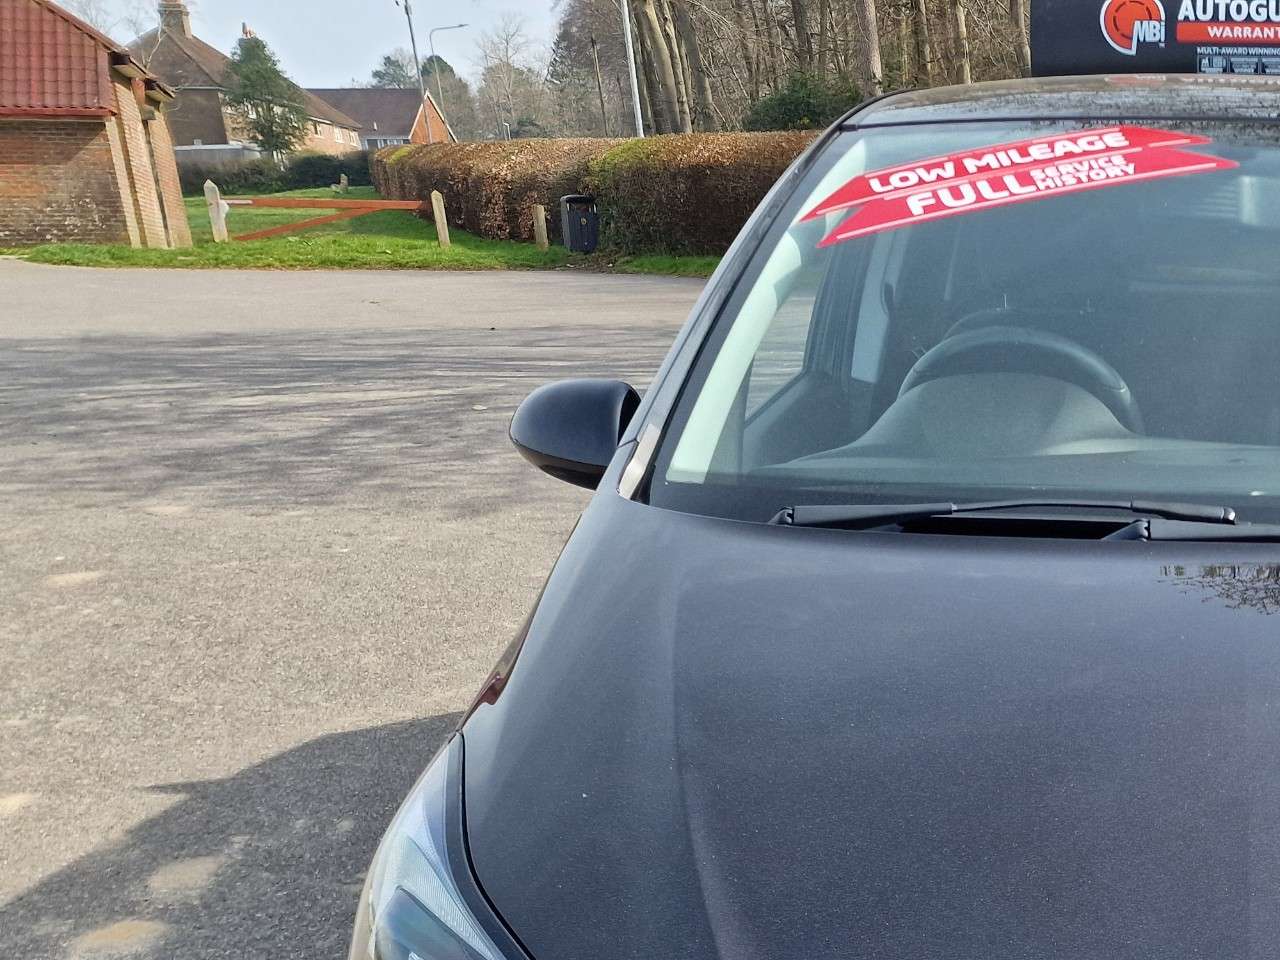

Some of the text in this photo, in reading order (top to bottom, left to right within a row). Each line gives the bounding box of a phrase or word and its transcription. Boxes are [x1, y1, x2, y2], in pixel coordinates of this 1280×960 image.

[1197, 46, 1248, 56] MULTI-AWARD
[1249, 47, 1280, 56] WINNING
[868, 132, 1130, 193] LOW MILEAGE
[1030, 155, 1127, 178] SERVICE
[1033, 163, 1136, 191] HISTORY
[906, 174, 1037, 216] FULL
